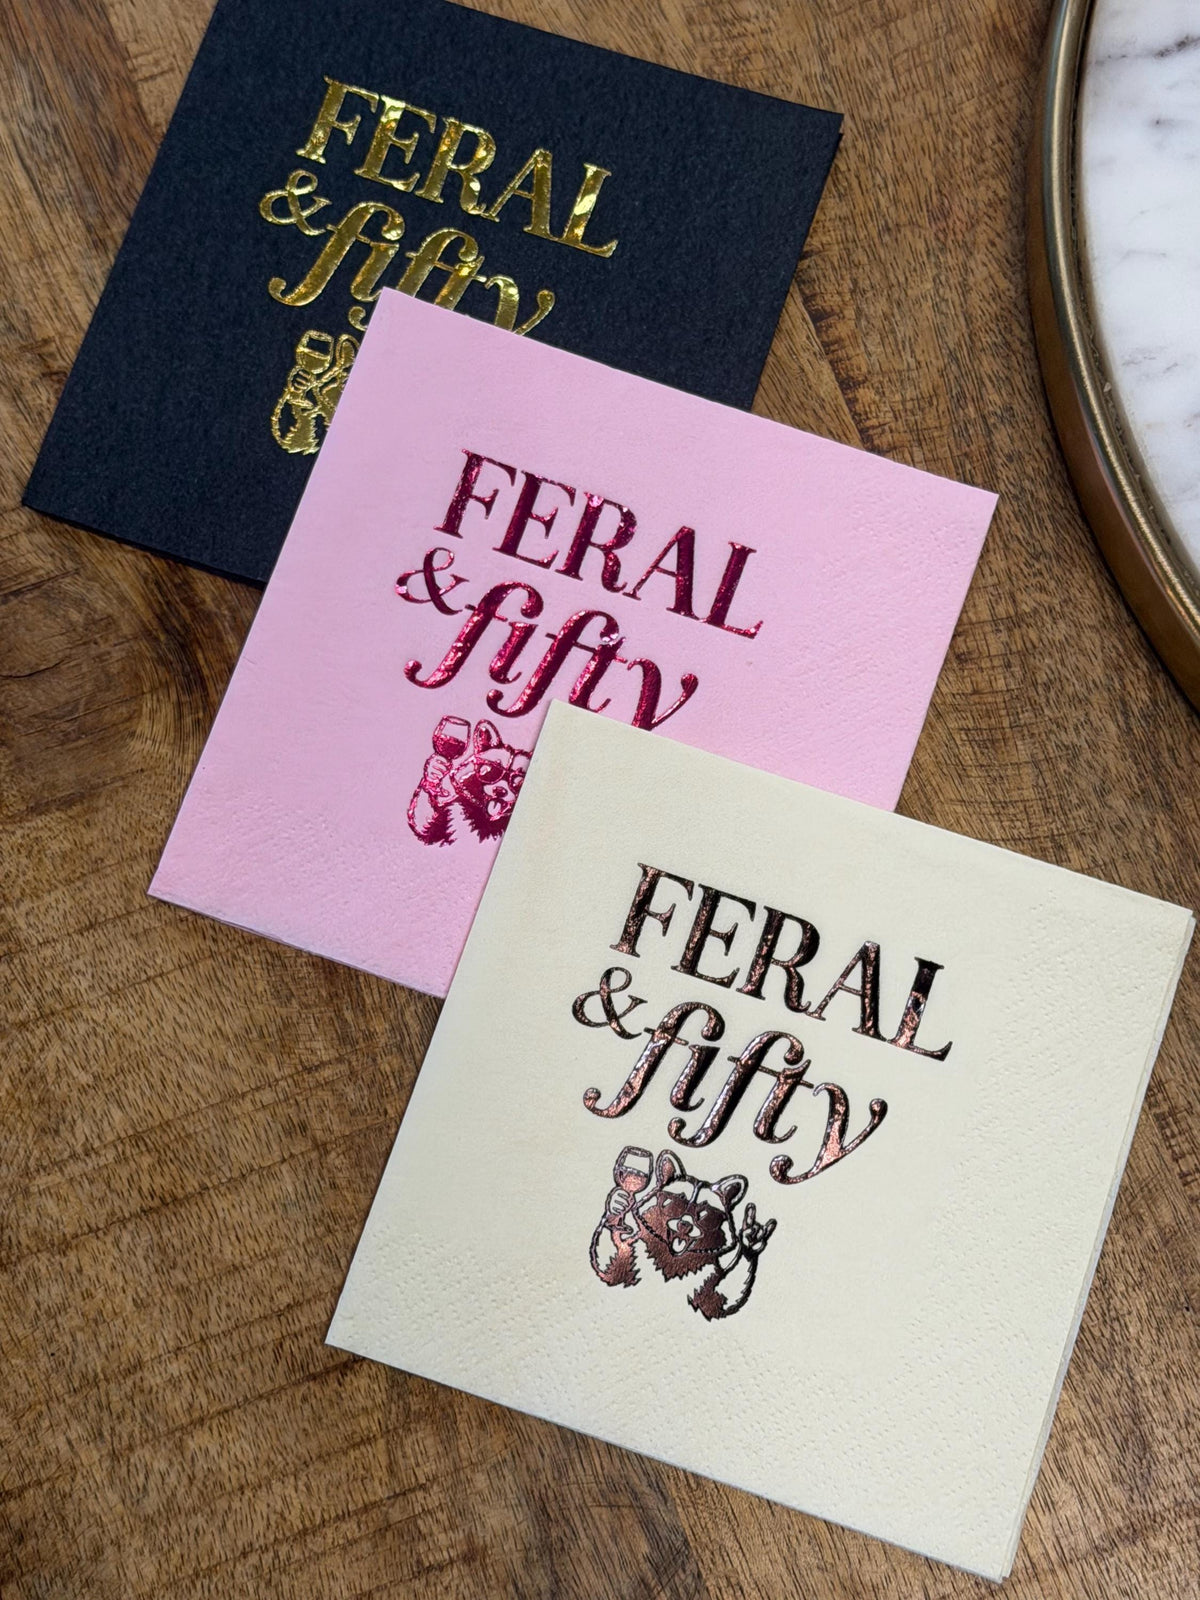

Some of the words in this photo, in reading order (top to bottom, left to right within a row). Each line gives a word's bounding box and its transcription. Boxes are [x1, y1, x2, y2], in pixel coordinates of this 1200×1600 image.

[259, 169, 332, 236] &
[296, 75, 618, 258] FERAL
[394, 547, 469, 616] &
[433, 448, 764, 639] FERAL
[403, 581, 699, 732] fifty
[572, 966, 648, 1040] &
[609, 862, 953, 1062] FERAL
[582, 1001, 888, 1185] fifty
